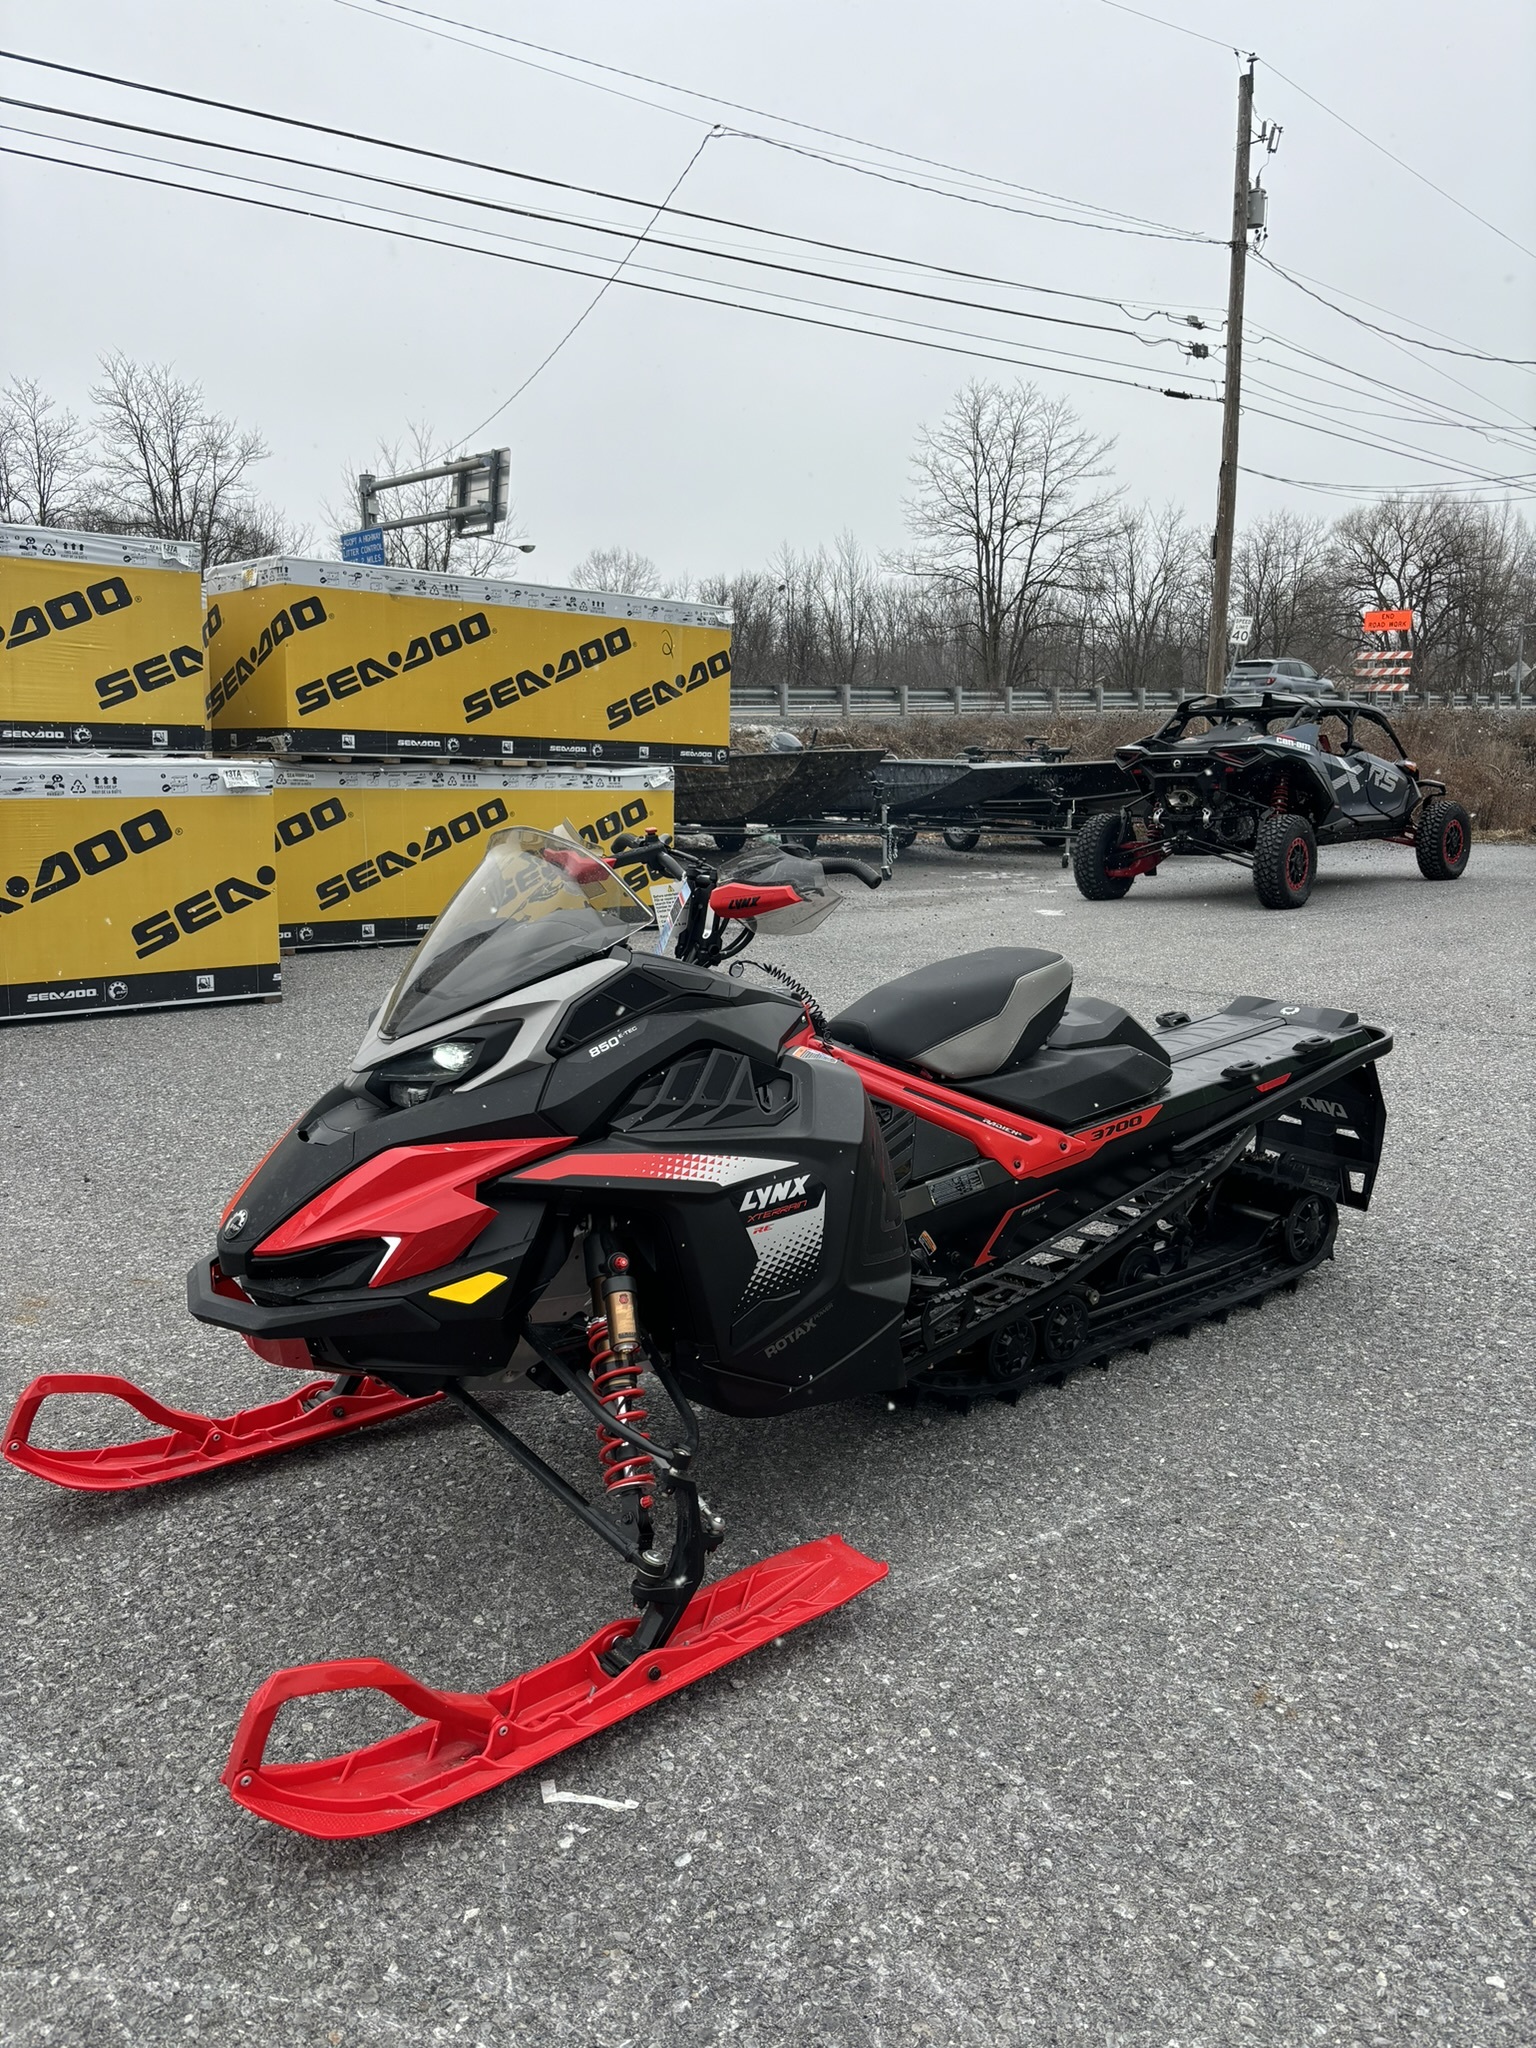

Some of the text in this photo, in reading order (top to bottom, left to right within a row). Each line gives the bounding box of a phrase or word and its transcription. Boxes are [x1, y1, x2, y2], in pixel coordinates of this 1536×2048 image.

[344, 543, 384, 558] LITTER CONTROL
[367, 554, 382, 564] MILES
[1235, 617, 1252, 625] SPEED
[1381, 612, 1395, 620] END
[1368, 620, 1407, 629] ROAD WORK
[1231, 630, 1249, 642] 40
[728, 895, 761, 910] LYNX
[588, 1025, 638, 1058] 850 E-TEC
[1090, 1115, 1143, 1142] 3700
[739, 1173, 811, 1213] LYNX
[752, 1223, 775, 1235] RE
[764, 1317, 817, 1359] ROTAX
